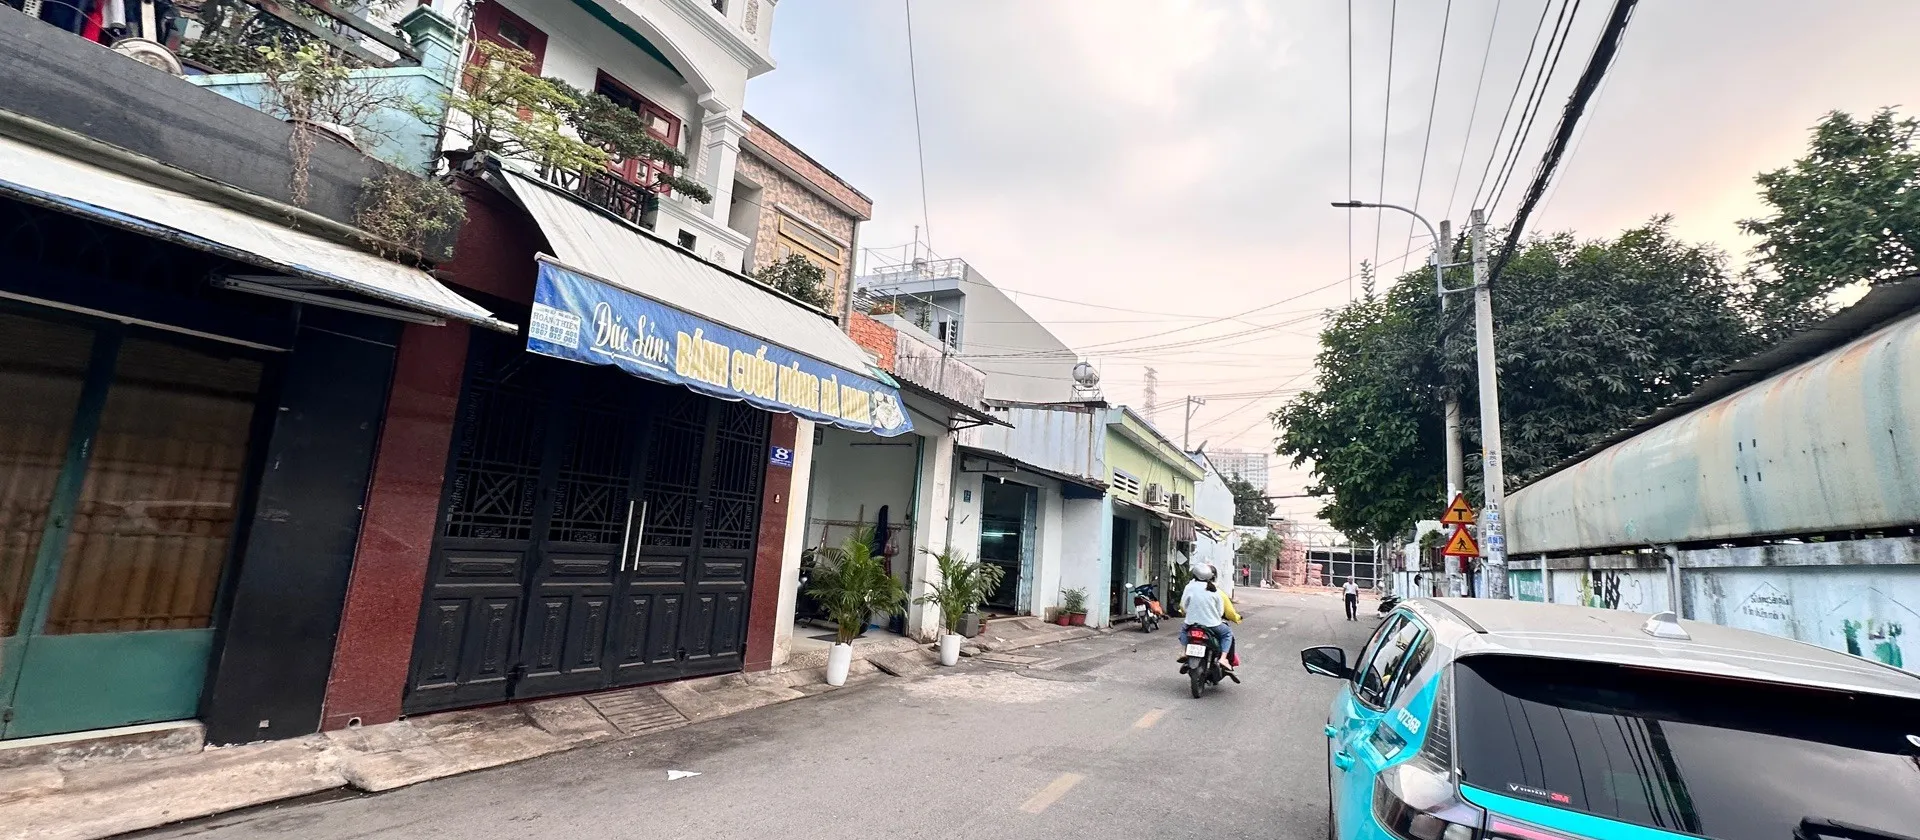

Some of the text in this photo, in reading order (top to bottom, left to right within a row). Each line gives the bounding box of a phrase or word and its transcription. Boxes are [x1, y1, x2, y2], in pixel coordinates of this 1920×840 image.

[632, 314, 670, 365] Sản:
[676, 328, 729, 388] BÁNH
[731, 345, 777, 401] CUỐN
[778, 361, 820, 413] NÓNG
[820, 374, 840, 418] HÀ
[775, 447, 789, 460] 8
[1551, 792, 1569, 804] 3M
